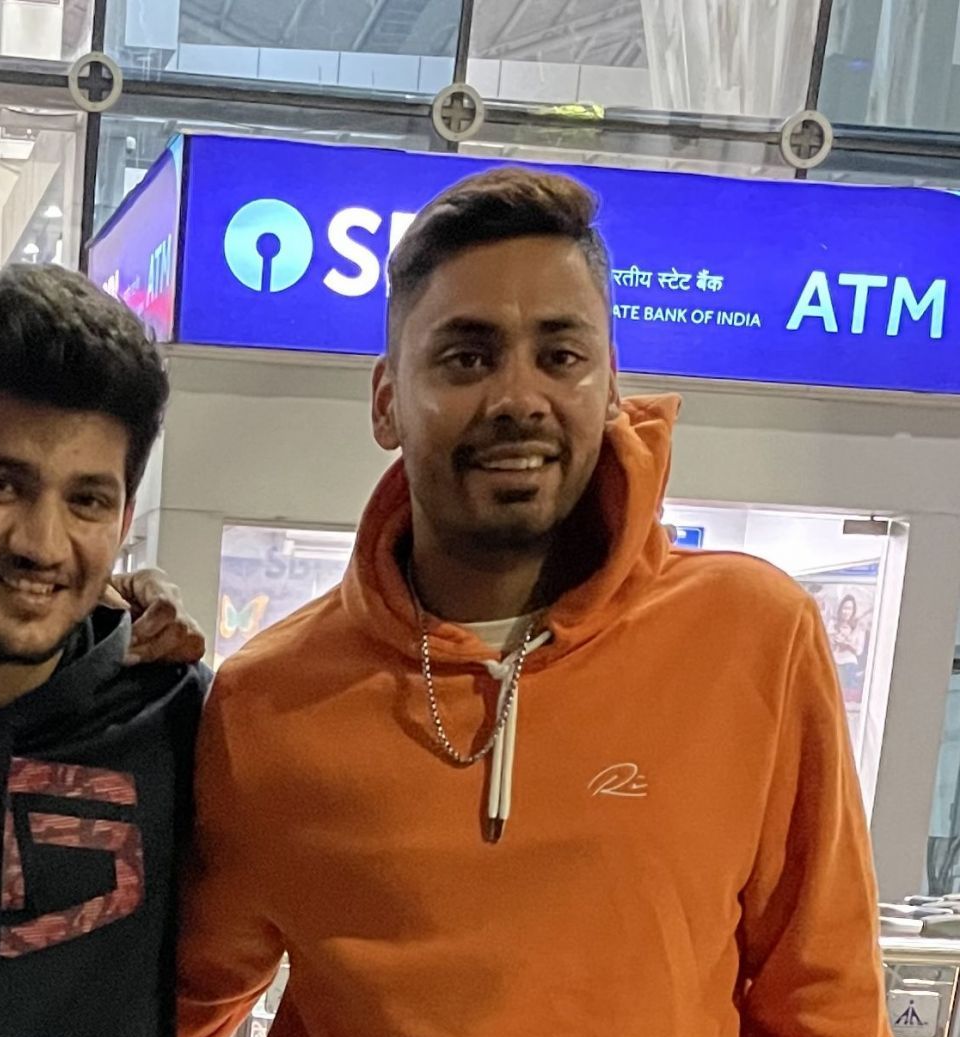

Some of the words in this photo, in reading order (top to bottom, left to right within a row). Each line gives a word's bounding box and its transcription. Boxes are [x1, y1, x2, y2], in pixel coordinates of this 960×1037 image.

[323, 207, 417, 297] S
[612, 264, 653, 288] रतीय
[613, 304, 640, 320] ATE
[644, 306, 687, 323] BANK
[691, 309, 714, 324] OF
[717, 311, 761, 328] INDIA
[785, 270, 947, 339] ATM
